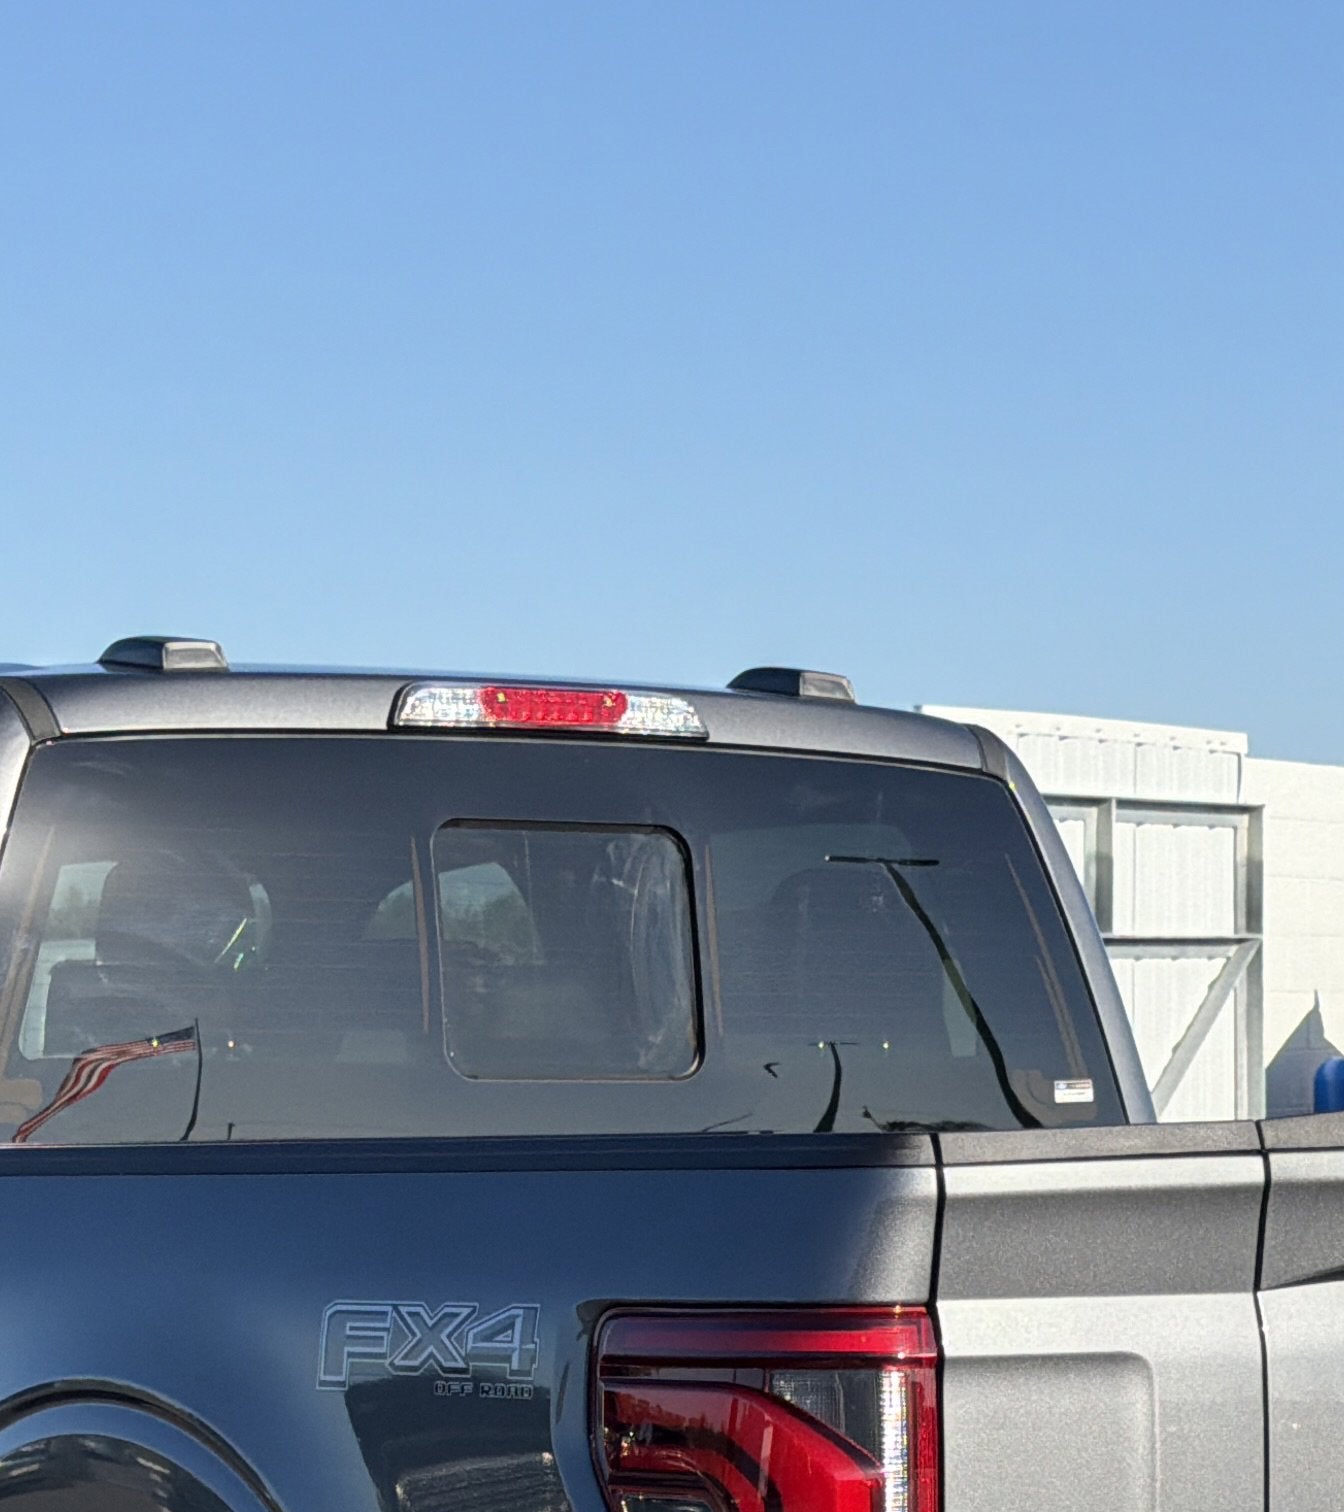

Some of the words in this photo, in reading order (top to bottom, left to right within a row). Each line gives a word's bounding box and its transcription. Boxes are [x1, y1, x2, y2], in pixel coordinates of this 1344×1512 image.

[316, 1300, 541, 1390] FX4
[434, 1381, 473, 1396] OFF
[478, 1383, 533, 1399] ROAD
